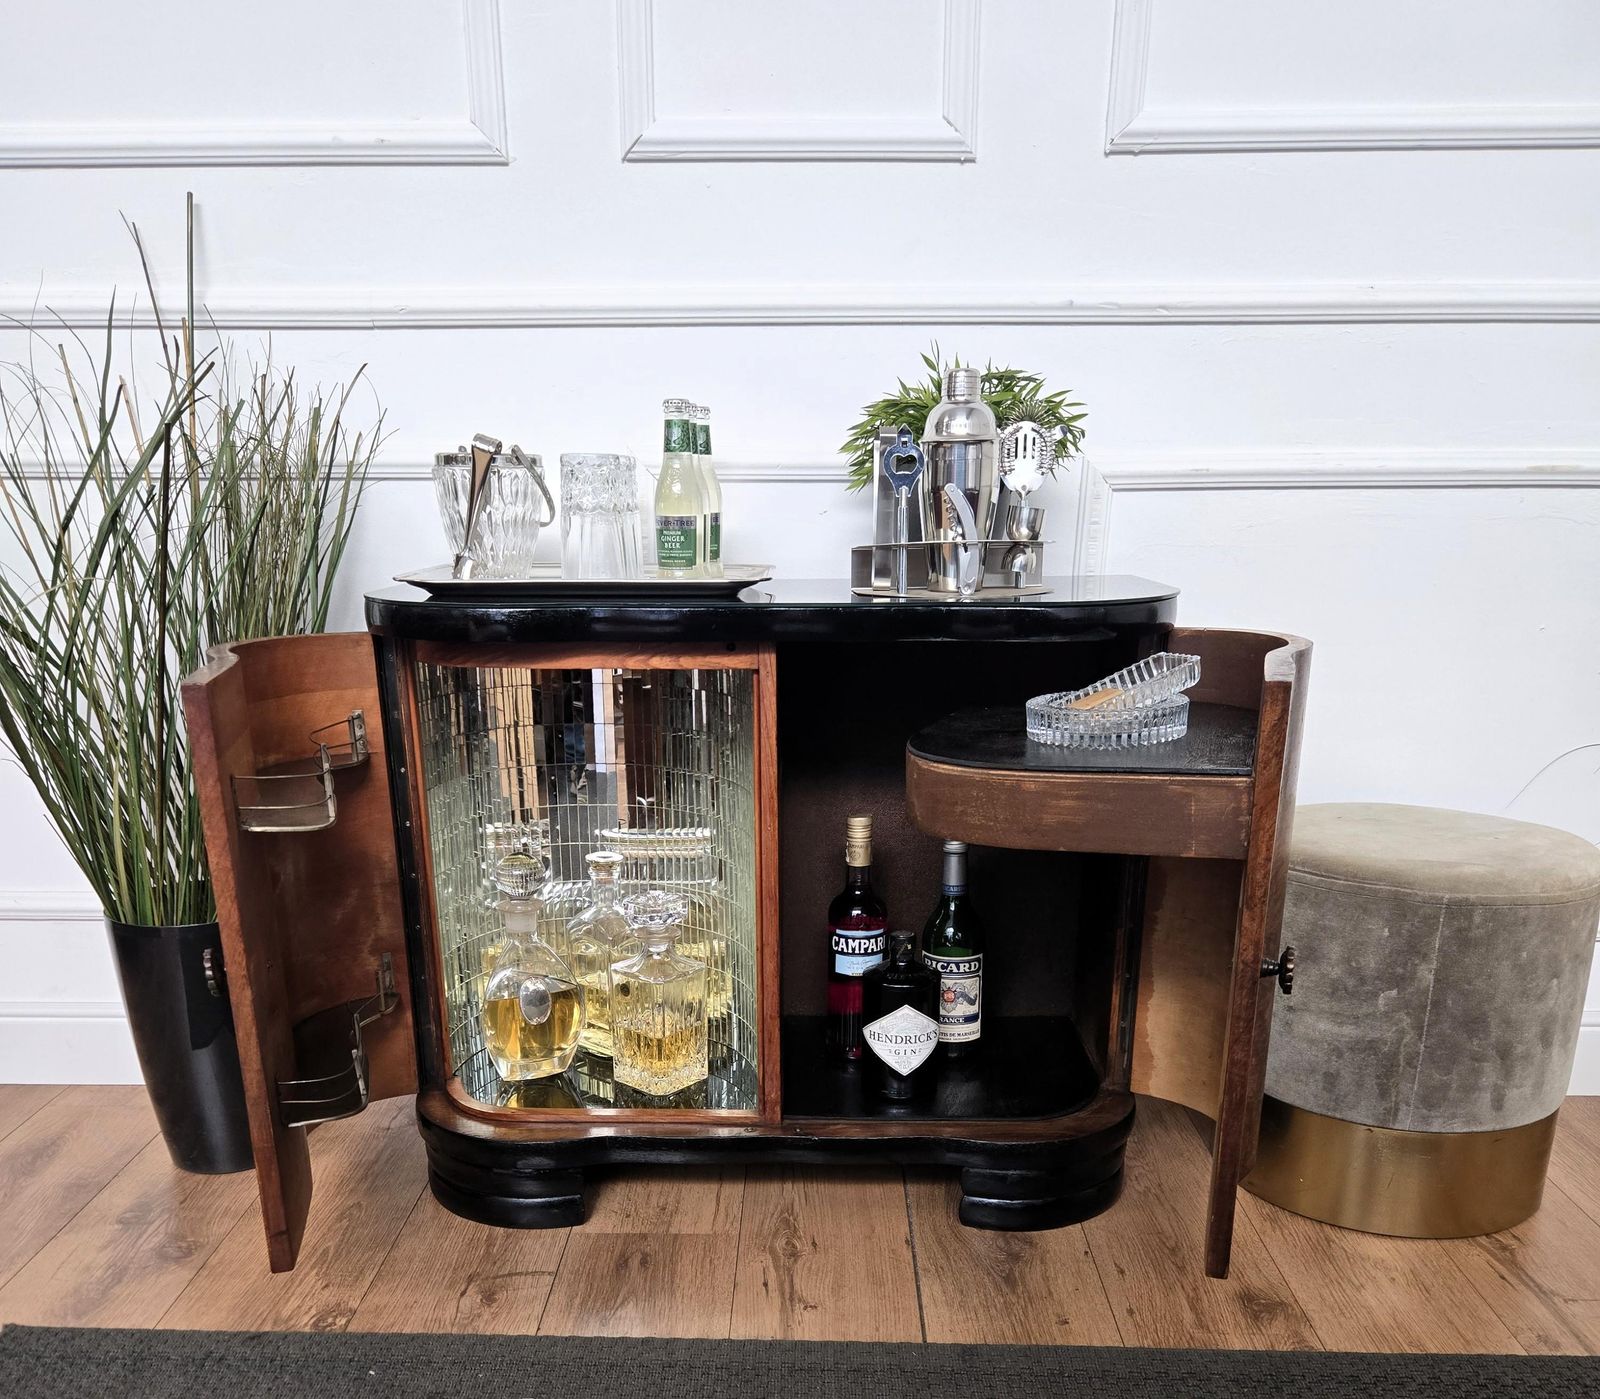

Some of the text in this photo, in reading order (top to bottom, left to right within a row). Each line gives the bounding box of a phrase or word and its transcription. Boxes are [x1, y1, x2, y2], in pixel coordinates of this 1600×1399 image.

[832, 935, 886, 954] CAMPARI
[924, 958, 979, 973] RICARD
[869, 1029, 938, 1045] HENDRICK'S
[894, 1048, 917, 1056] GIN
